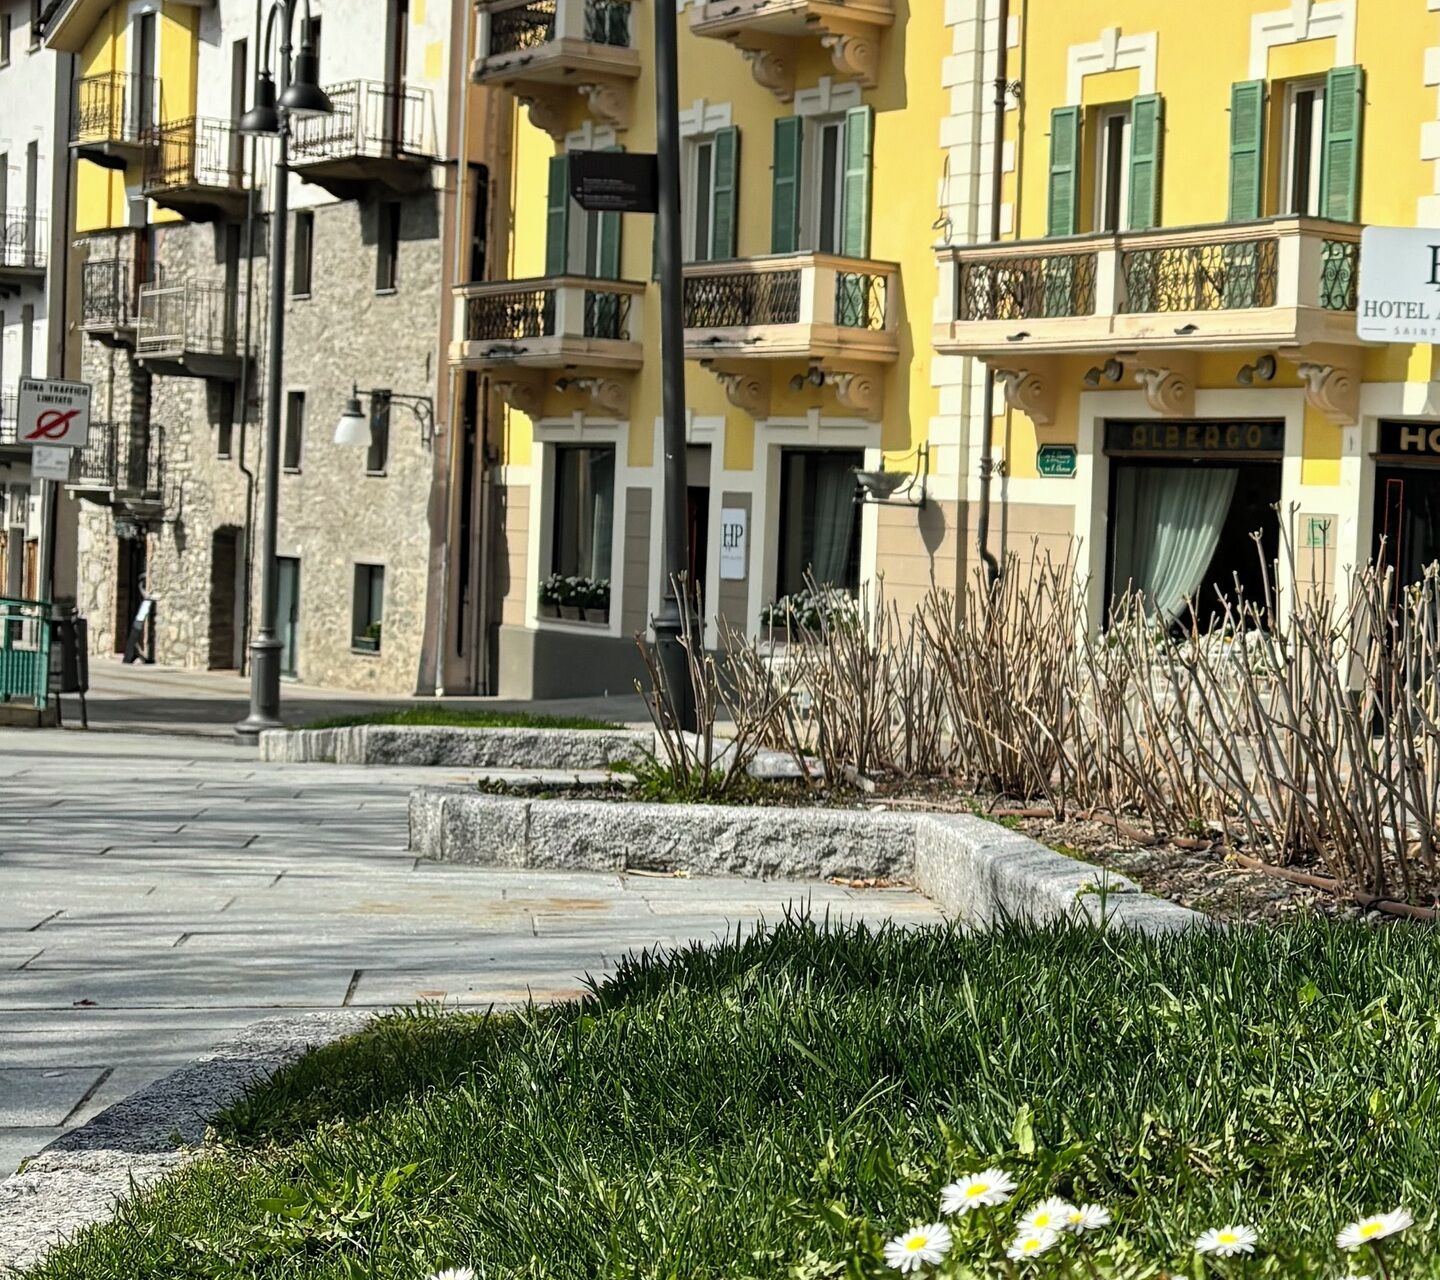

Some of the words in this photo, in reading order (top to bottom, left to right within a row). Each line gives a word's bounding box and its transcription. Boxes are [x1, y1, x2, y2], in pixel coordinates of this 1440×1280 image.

[1363, 300, 1430, 320] HOTEL
[1394, 326, 1437, 337] SAINT
[23, 381, 44, 393] ZONA
[49, 384, 88, 396] TRAFFICO
[1132, 425, 1262, 449] ALBERGO
